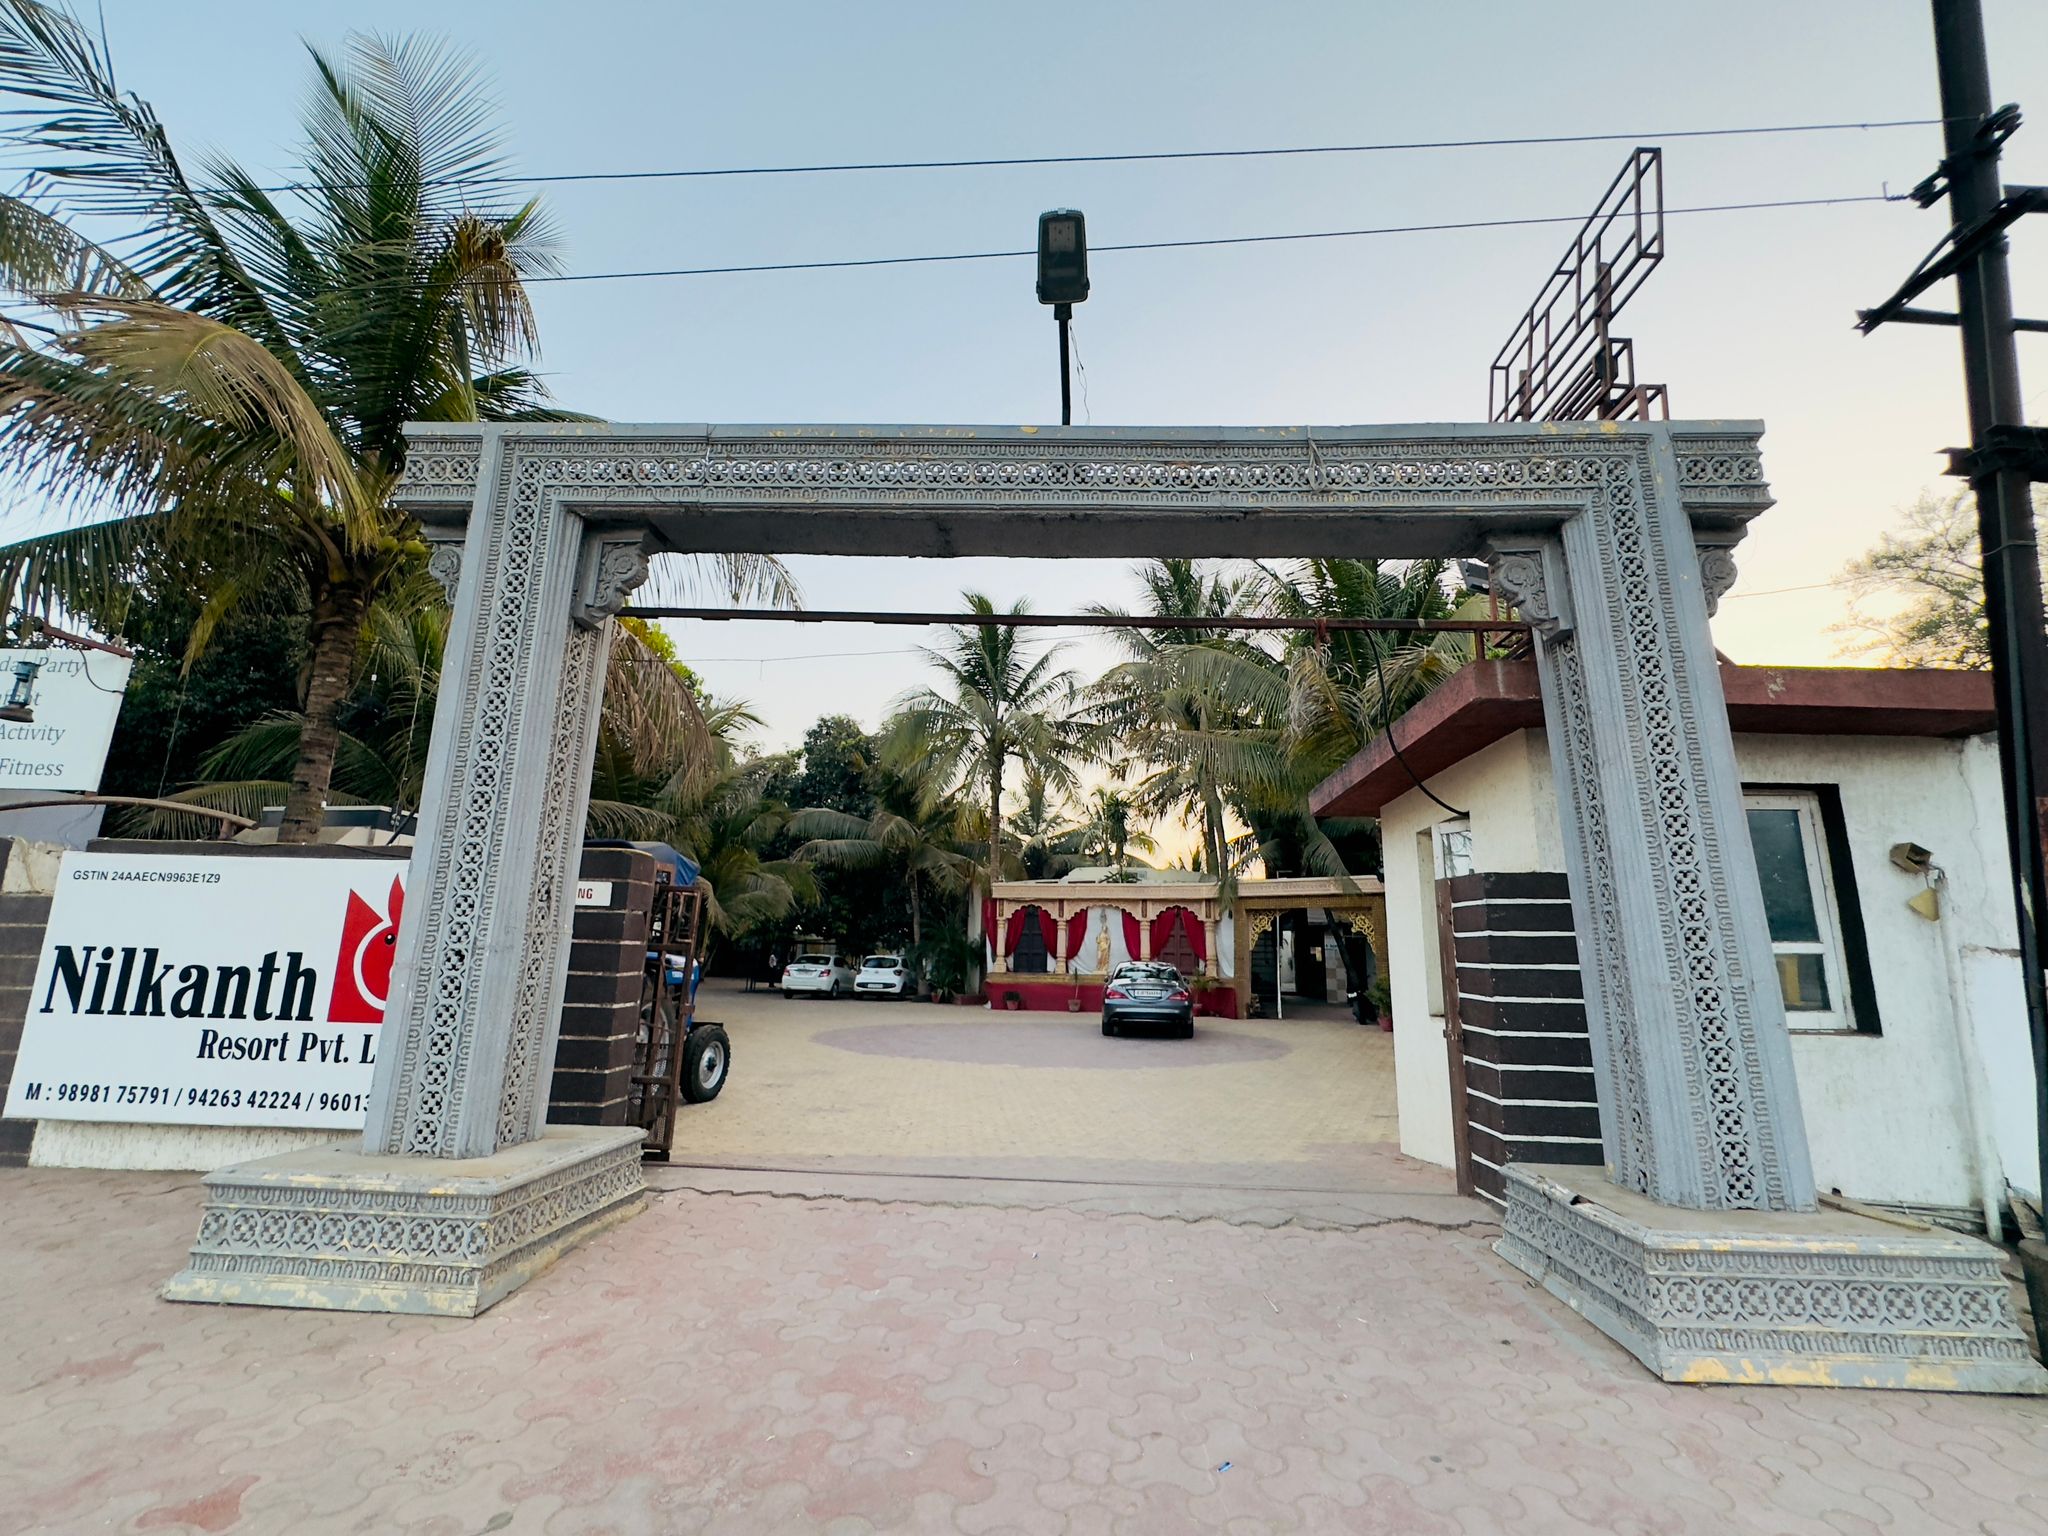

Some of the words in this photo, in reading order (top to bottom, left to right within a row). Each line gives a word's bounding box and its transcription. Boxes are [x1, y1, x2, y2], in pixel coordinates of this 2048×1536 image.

[39, 656, 86, 678] Party
[0, 758, 64, 776] Fitness
[73, 870, 109, 881] GSTIN
[111, 871, 221, 884] 24AAECN9963E1Z9
[40, 945, 318, 1022] Nilkanth
[196, 1029, 290, 1062] Resort
[297, 1032, 349, 1064] Pvt.
[58, 1083, 110, 1103] 98981
[116, 1085, 170, 1105] 75791
[188, 1088, 242, 1107] 94263
[247, 1090, 302, 1110] 42224
